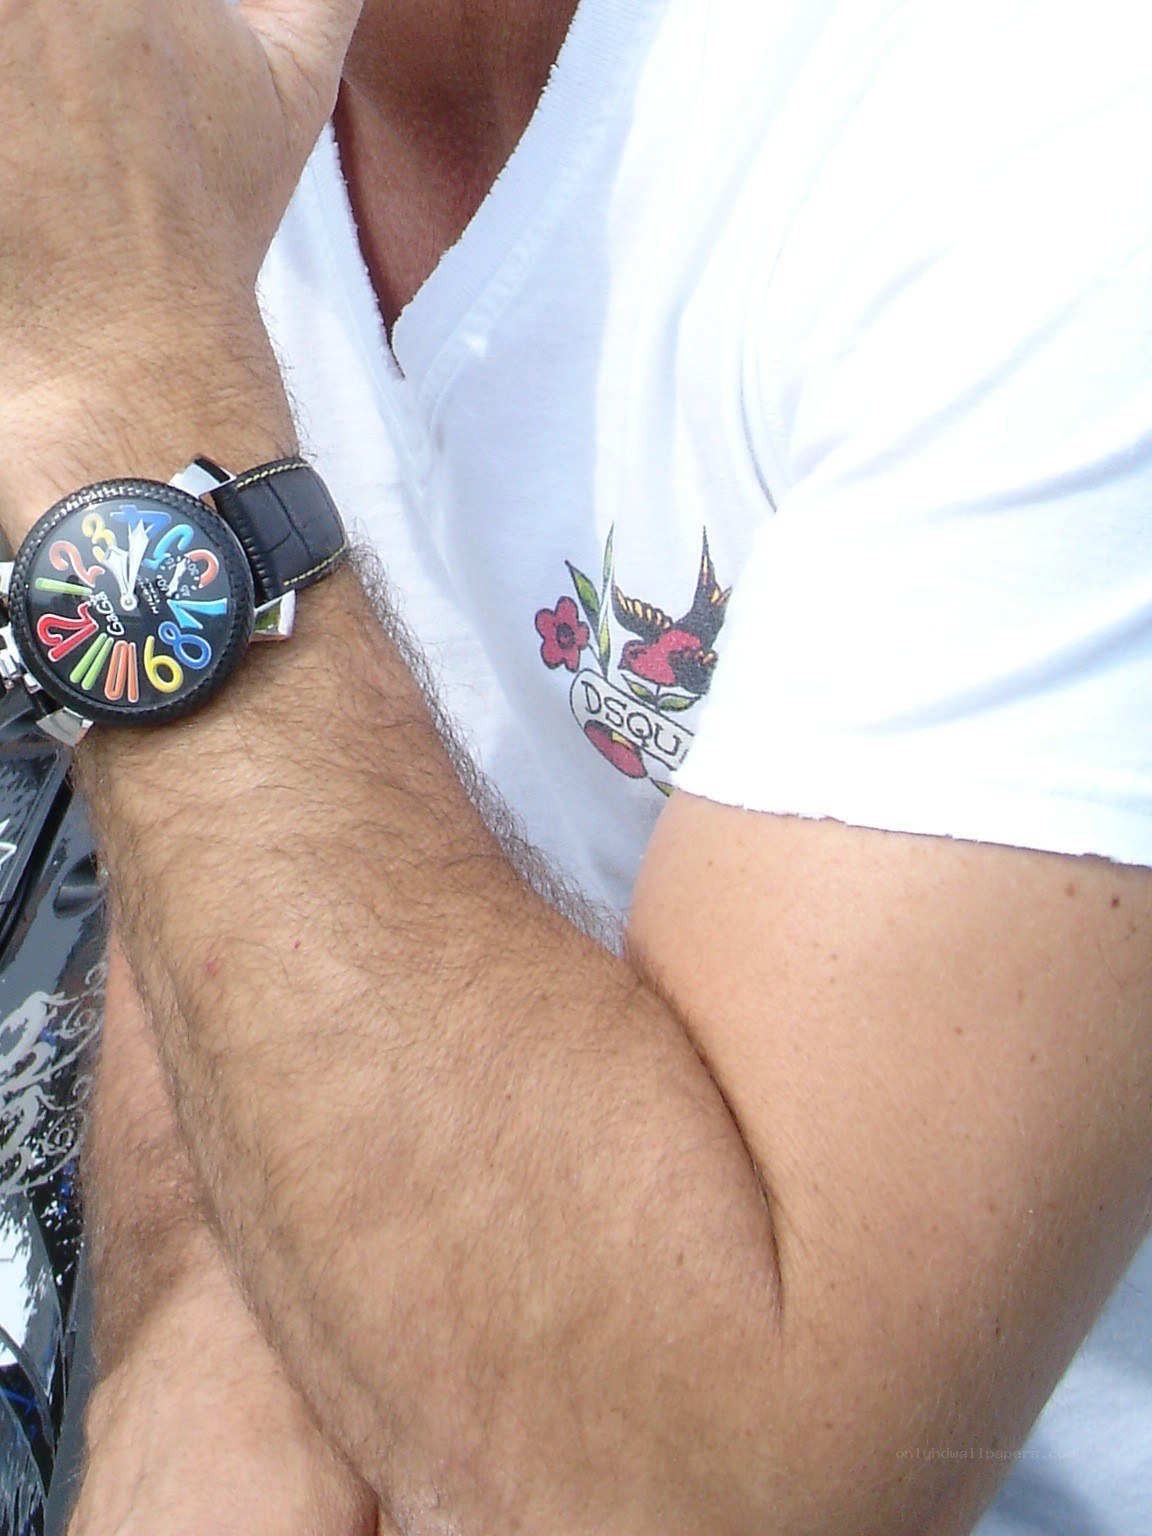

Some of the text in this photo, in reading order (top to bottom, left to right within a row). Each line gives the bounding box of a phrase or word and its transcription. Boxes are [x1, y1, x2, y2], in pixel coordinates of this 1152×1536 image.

[49, 540, 105, 588] 2
[37, 601, 99, 662] 12
[166, 596, 228, 630] 7
[69, 632, 114, 691] 11
[103, 640, 140, 703] 10
[144, 635, 184, 693] 9
[158, 621, 212, 669] 8
[580, 679, 688, 765] DSQU
